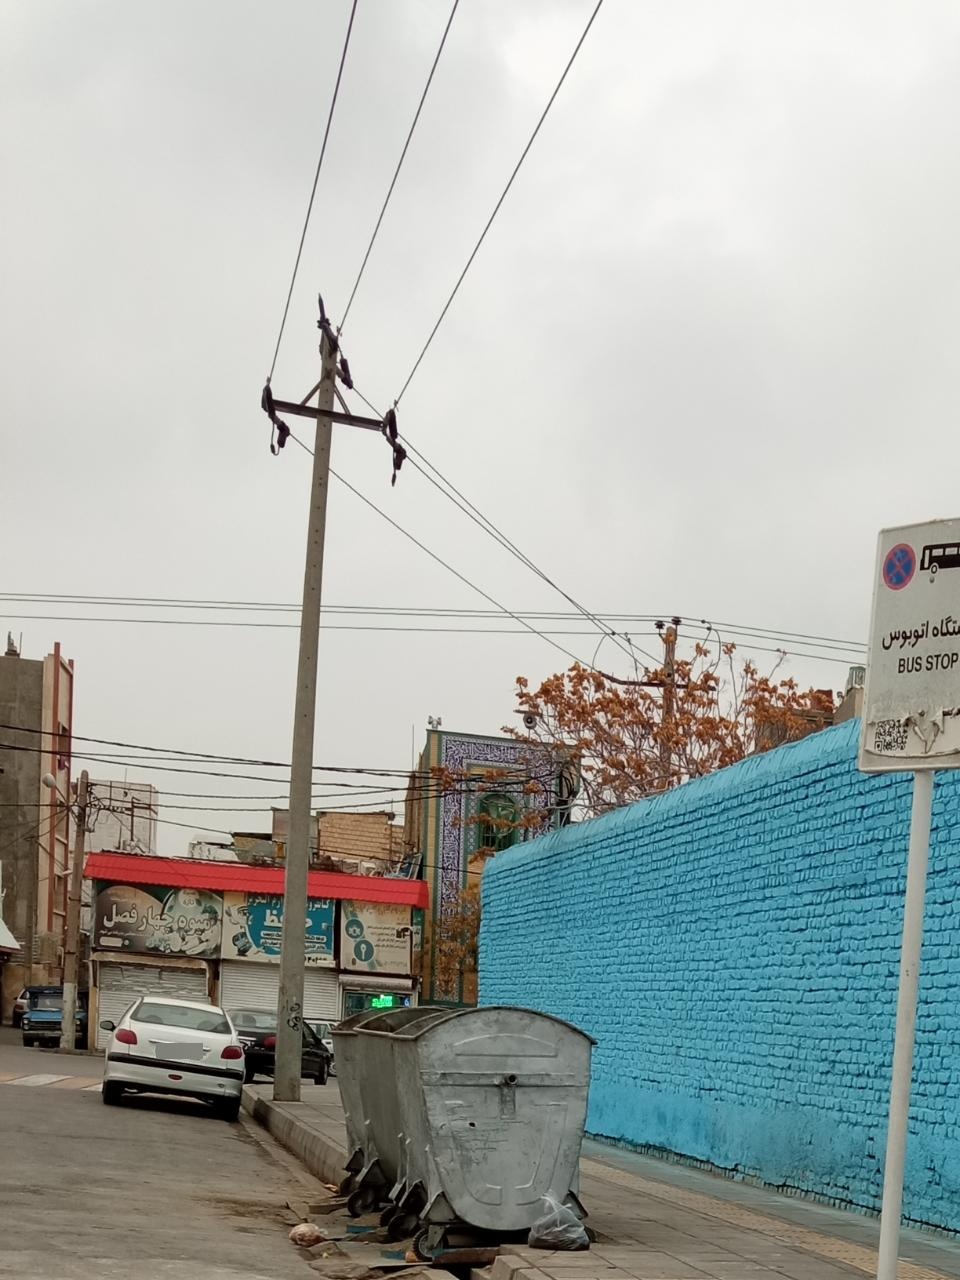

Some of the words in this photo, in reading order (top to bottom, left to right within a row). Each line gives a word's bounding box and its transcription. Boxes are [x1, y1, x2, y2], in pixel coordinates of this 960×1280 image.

[882, 620, 929, 650] اتوبوس
[898, 656, 922, 673] BUS
[925, 653, 959, 671] STOP
[103, 903, 138, 928] فصل
[138, 906, 174, 934] چهار
[178, 915, 212, 936] میوه
